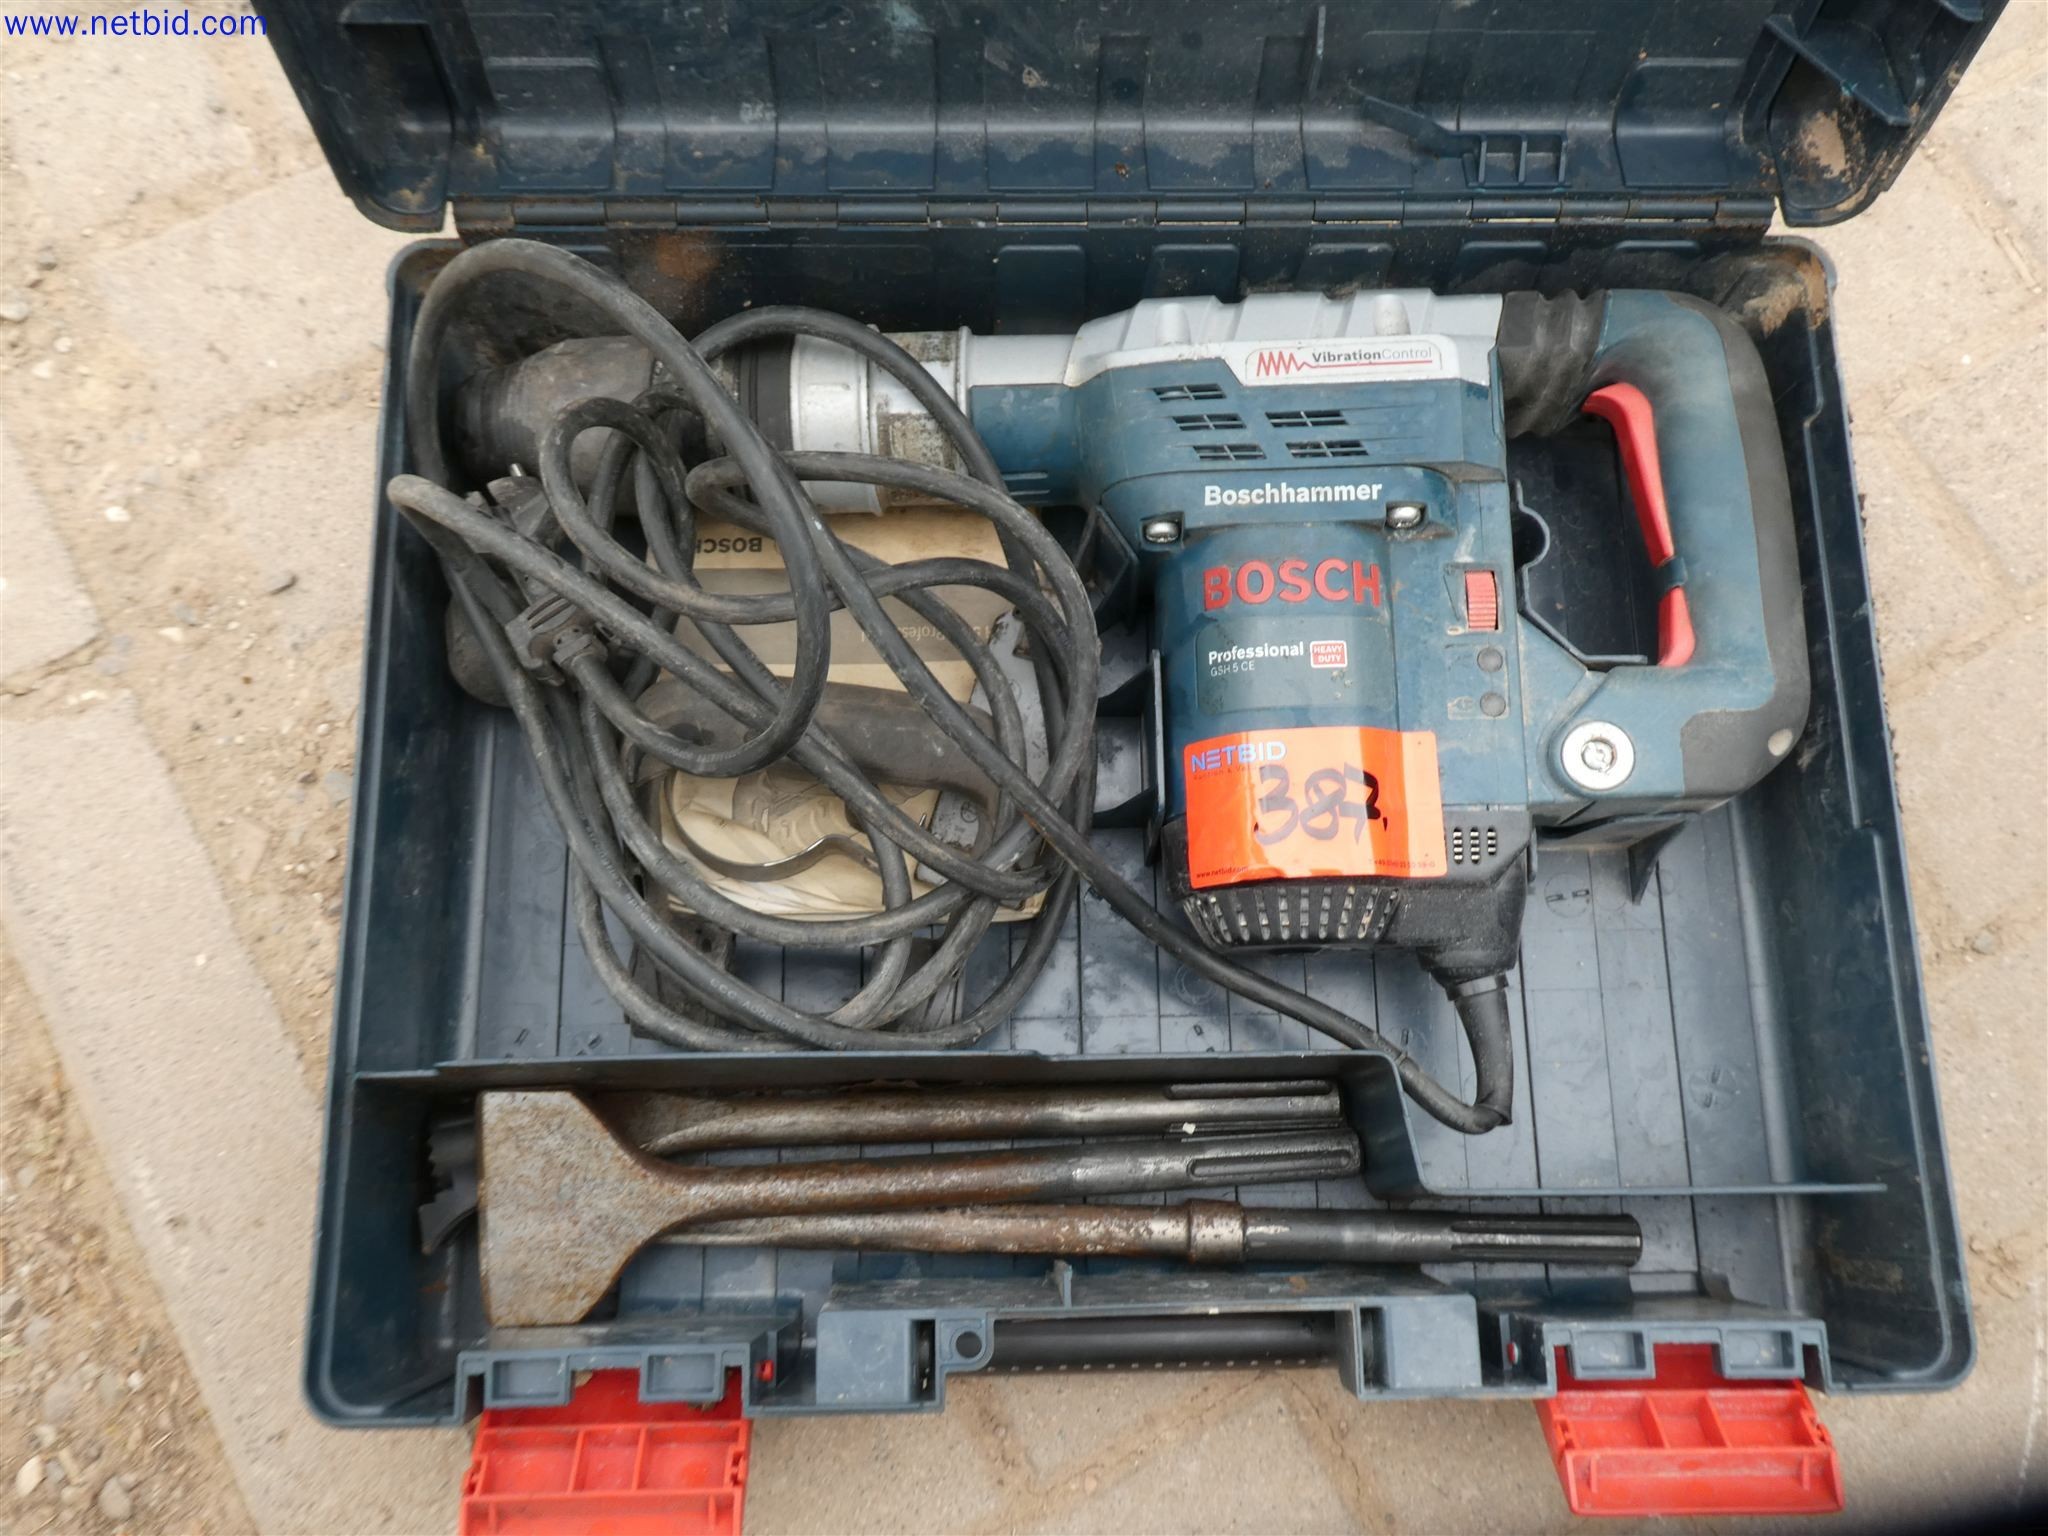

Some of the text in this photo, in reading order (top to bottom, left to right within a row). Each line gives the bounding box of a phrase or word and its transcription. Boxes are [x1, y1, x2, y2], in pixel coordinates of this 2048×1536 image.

[1204, 481, 1382, 506] Boschhammer
[1203, 558, 1381, 612] BOSCH
[1208, 641, 1305, 665] Professional
[1313, 645, 1343, 654] HEAVY
[1317, 654, 1342, 663] DUTY
[1210, 660, 1256, 677] GSH 5 CE
[1191, 741, 1287, 773] NETBID
